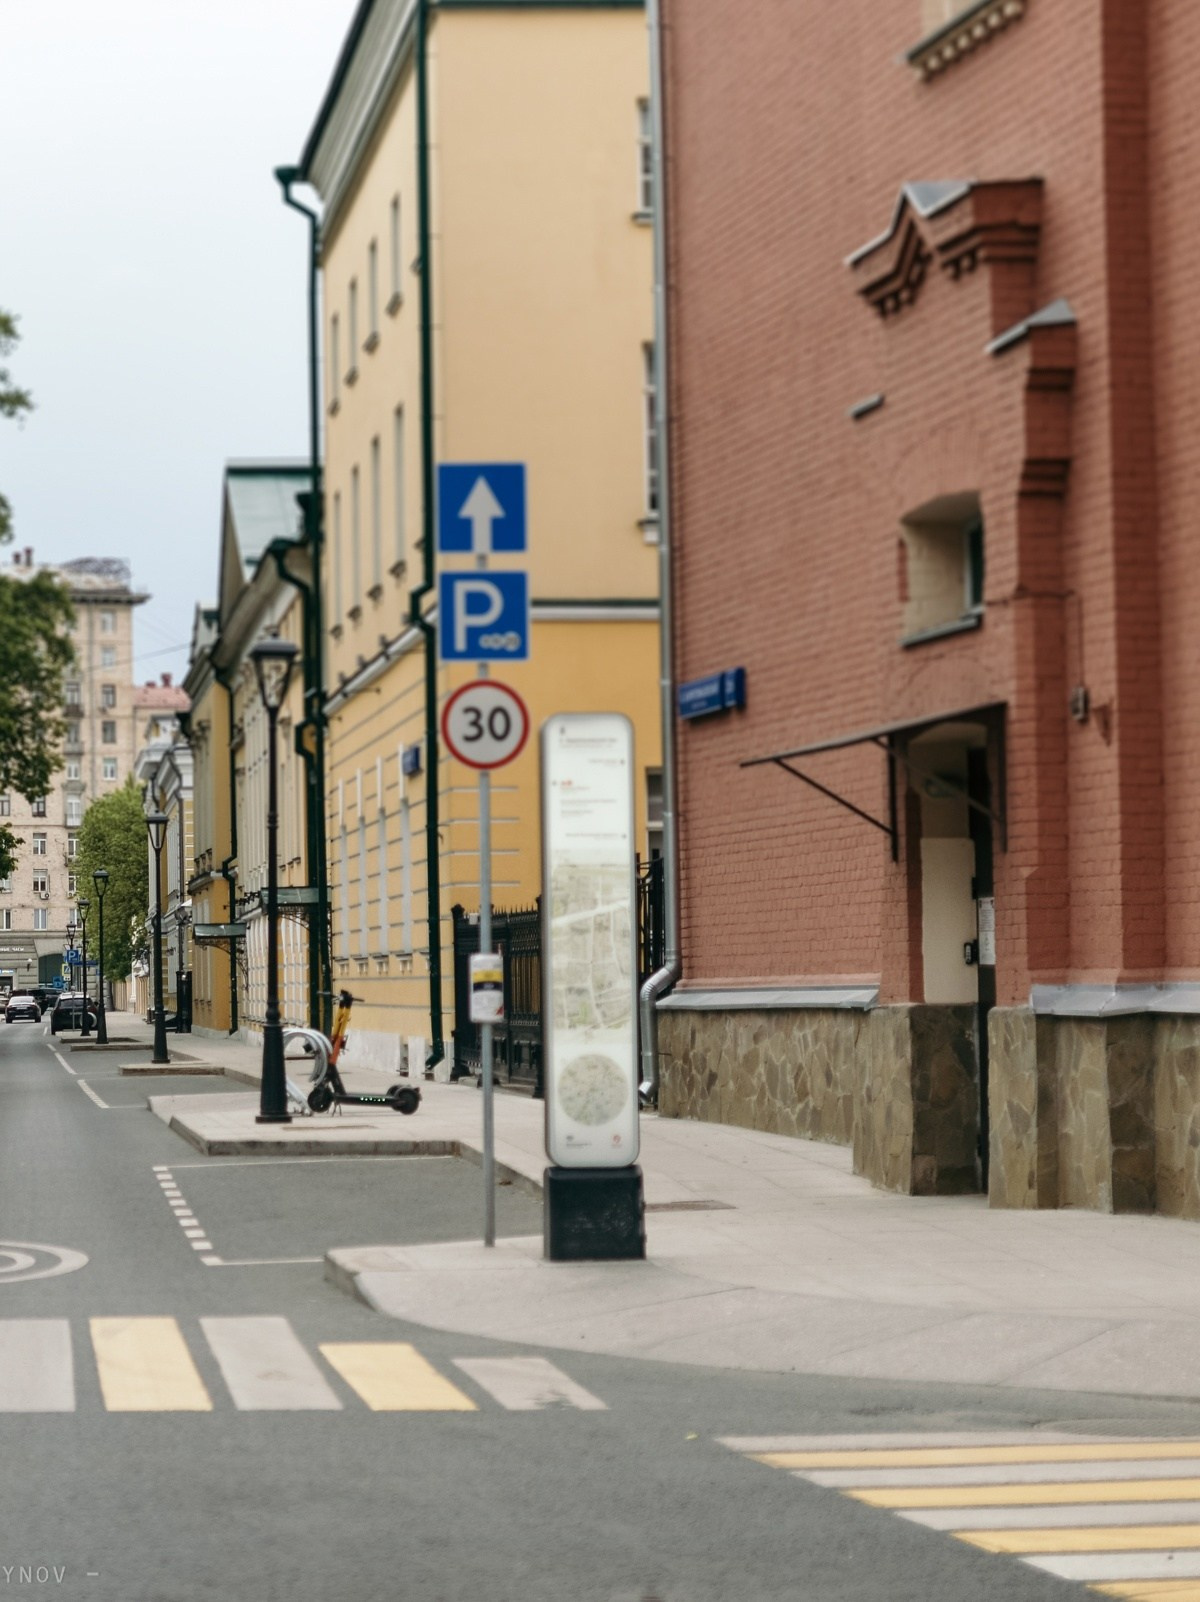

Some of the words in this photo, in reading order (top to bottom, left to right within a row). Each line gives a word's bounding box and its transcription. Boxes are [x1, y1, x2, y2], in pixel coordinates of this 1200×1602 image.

[453, 579, 504, 652] P
[462, 706, 511, 742] 30
[68, 950, 76, 961] P
